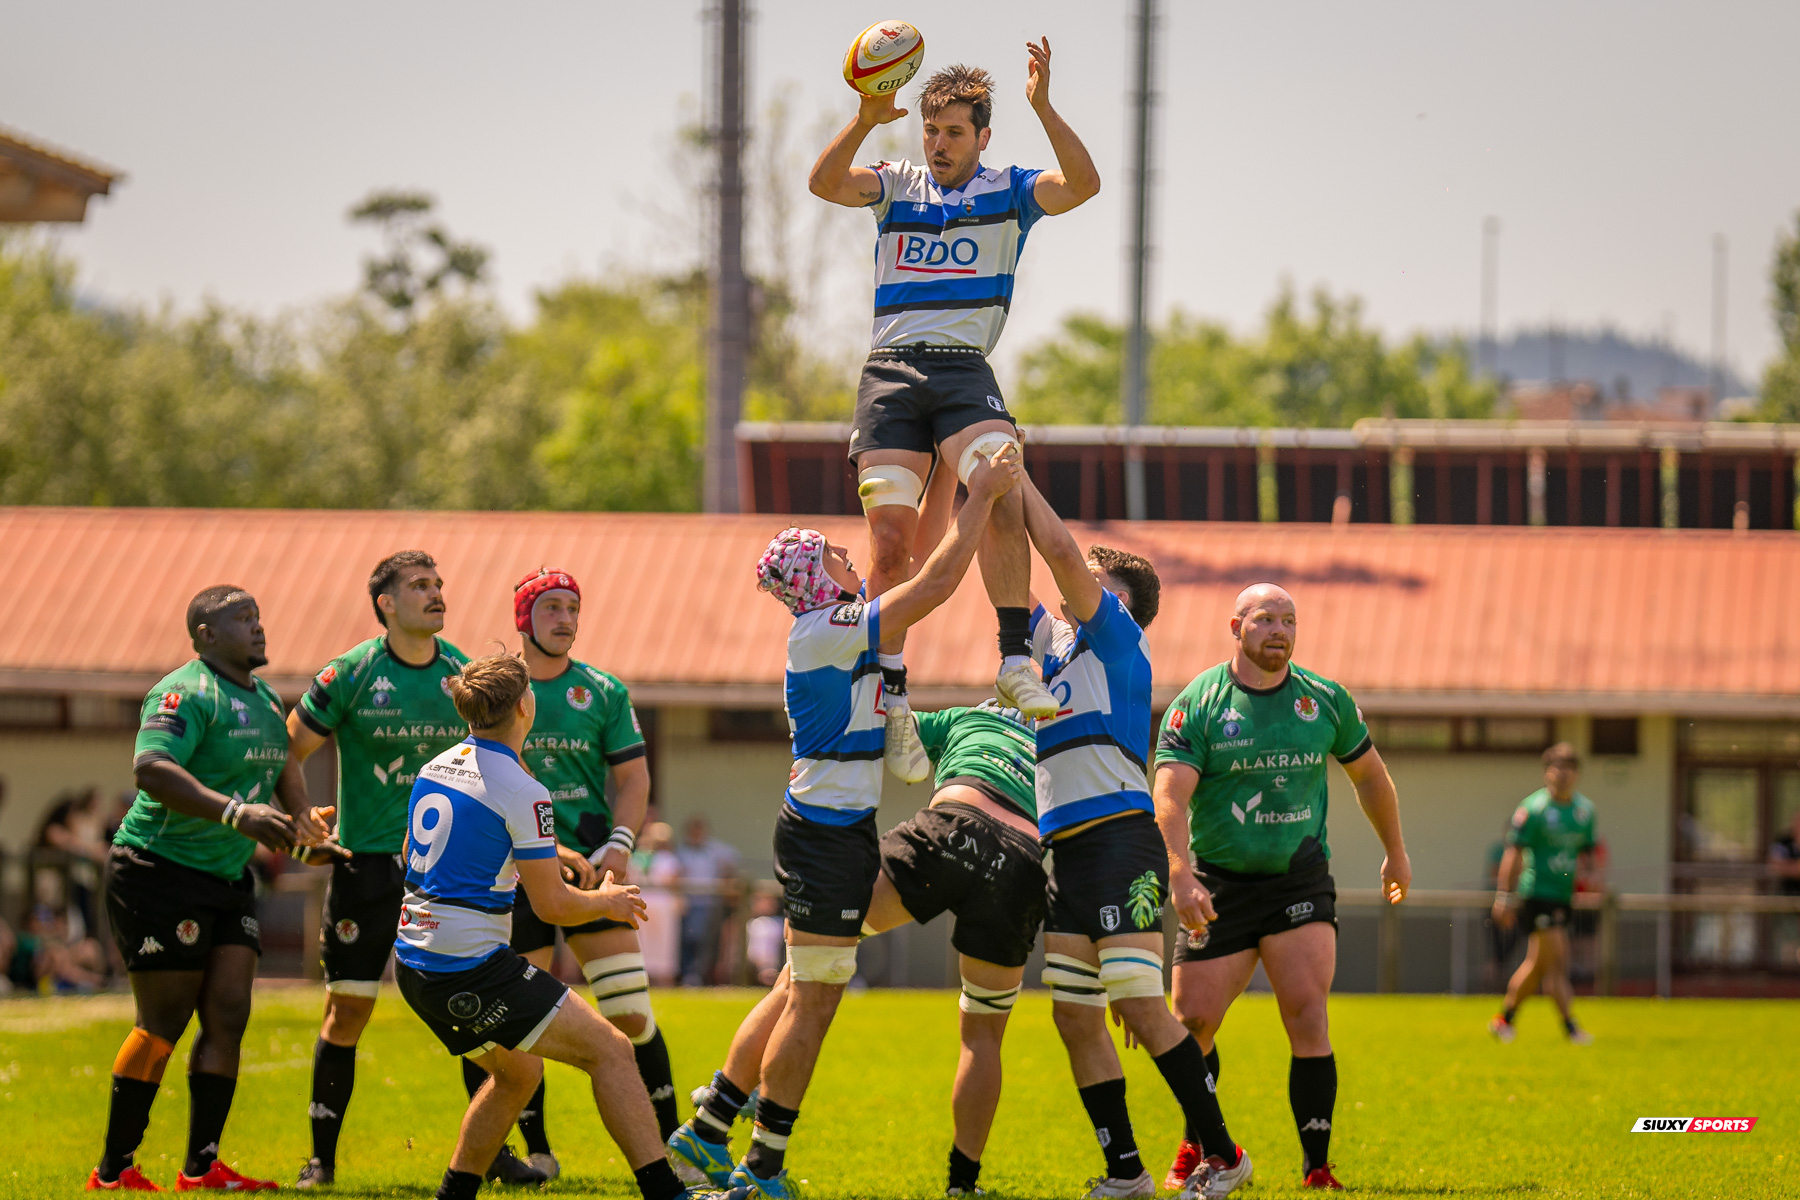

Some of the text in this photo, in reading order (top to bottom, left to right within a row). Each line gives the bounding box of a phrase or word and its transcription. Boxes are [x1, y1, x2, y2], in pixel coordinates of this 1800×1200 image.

[903, 235, 979, 266] BDO
[373, 725, 465, 738] ALAKRANA
[524, 736, 589, 752] AKRANA
[1211, 738, 1255, 751] CRONIMET
[1230, 752, 1322, 771] ALAKRANA
[396, 771, 417, 785] Int
[537, 804, 553, 816] San
[410, 792, 454, 873] 9
